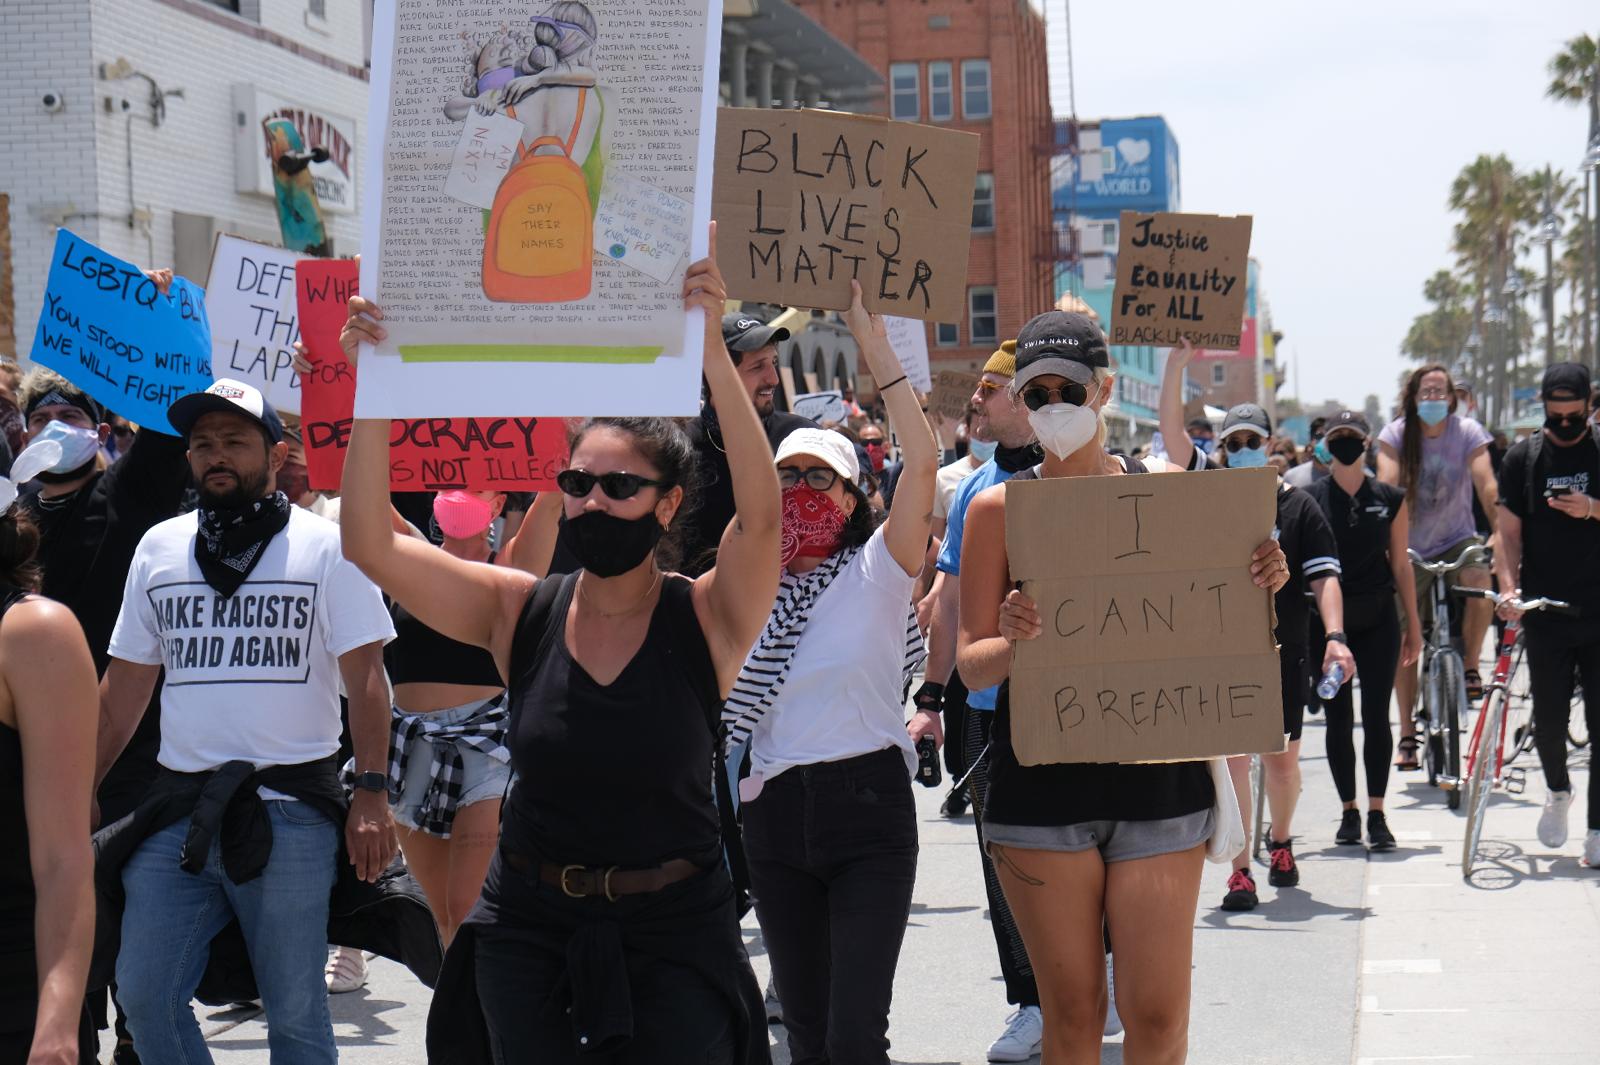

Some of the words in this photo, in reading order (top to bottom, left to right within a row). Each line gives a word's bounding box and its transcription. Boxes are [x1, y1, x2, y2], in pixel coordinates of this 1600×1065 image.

[427, 20, 458, 30] GURLEY
[499, 8, 529, 16] MANN
[648, 9, 703, 17] ANDERSON
[737, 129, 938, 209] BLACK
[1094, 177, 1152, 196] WORLD
[527, 202, 553, 214] SAY
[749, 189, 901, 259] LIVES
[521, 219, 561, 231] THEIR
[1132, 218, 1209, 252] Justice
[520, 237, 565, 249] NAMES
[62, 241, 158, 311] LGBTQ
[749, 240, 932, 312] MATTER
[1167, 295, 1203, 321] ALL
[43, 324, 73, 356] WE
[80, 347, 118, 387] WILL
[88, 324, 144, 363] STOOD
[155, 352, 191, 374] WITH
[1024, 339, 1045, 349] SWIM
[1049, 338, 1079, 346] NAKED
[309, 360, 354, 385] FOR
[421, 456, 470, 483] NOT
[1114, 493, 1154, 560] I
[212, 595, 309, 629] RACISTS
[1055, 582, 1229, 638] CAN'T
[229, 636, 300, 668] AGAIN
[1054, 683, 1264, 735] BREATHE
